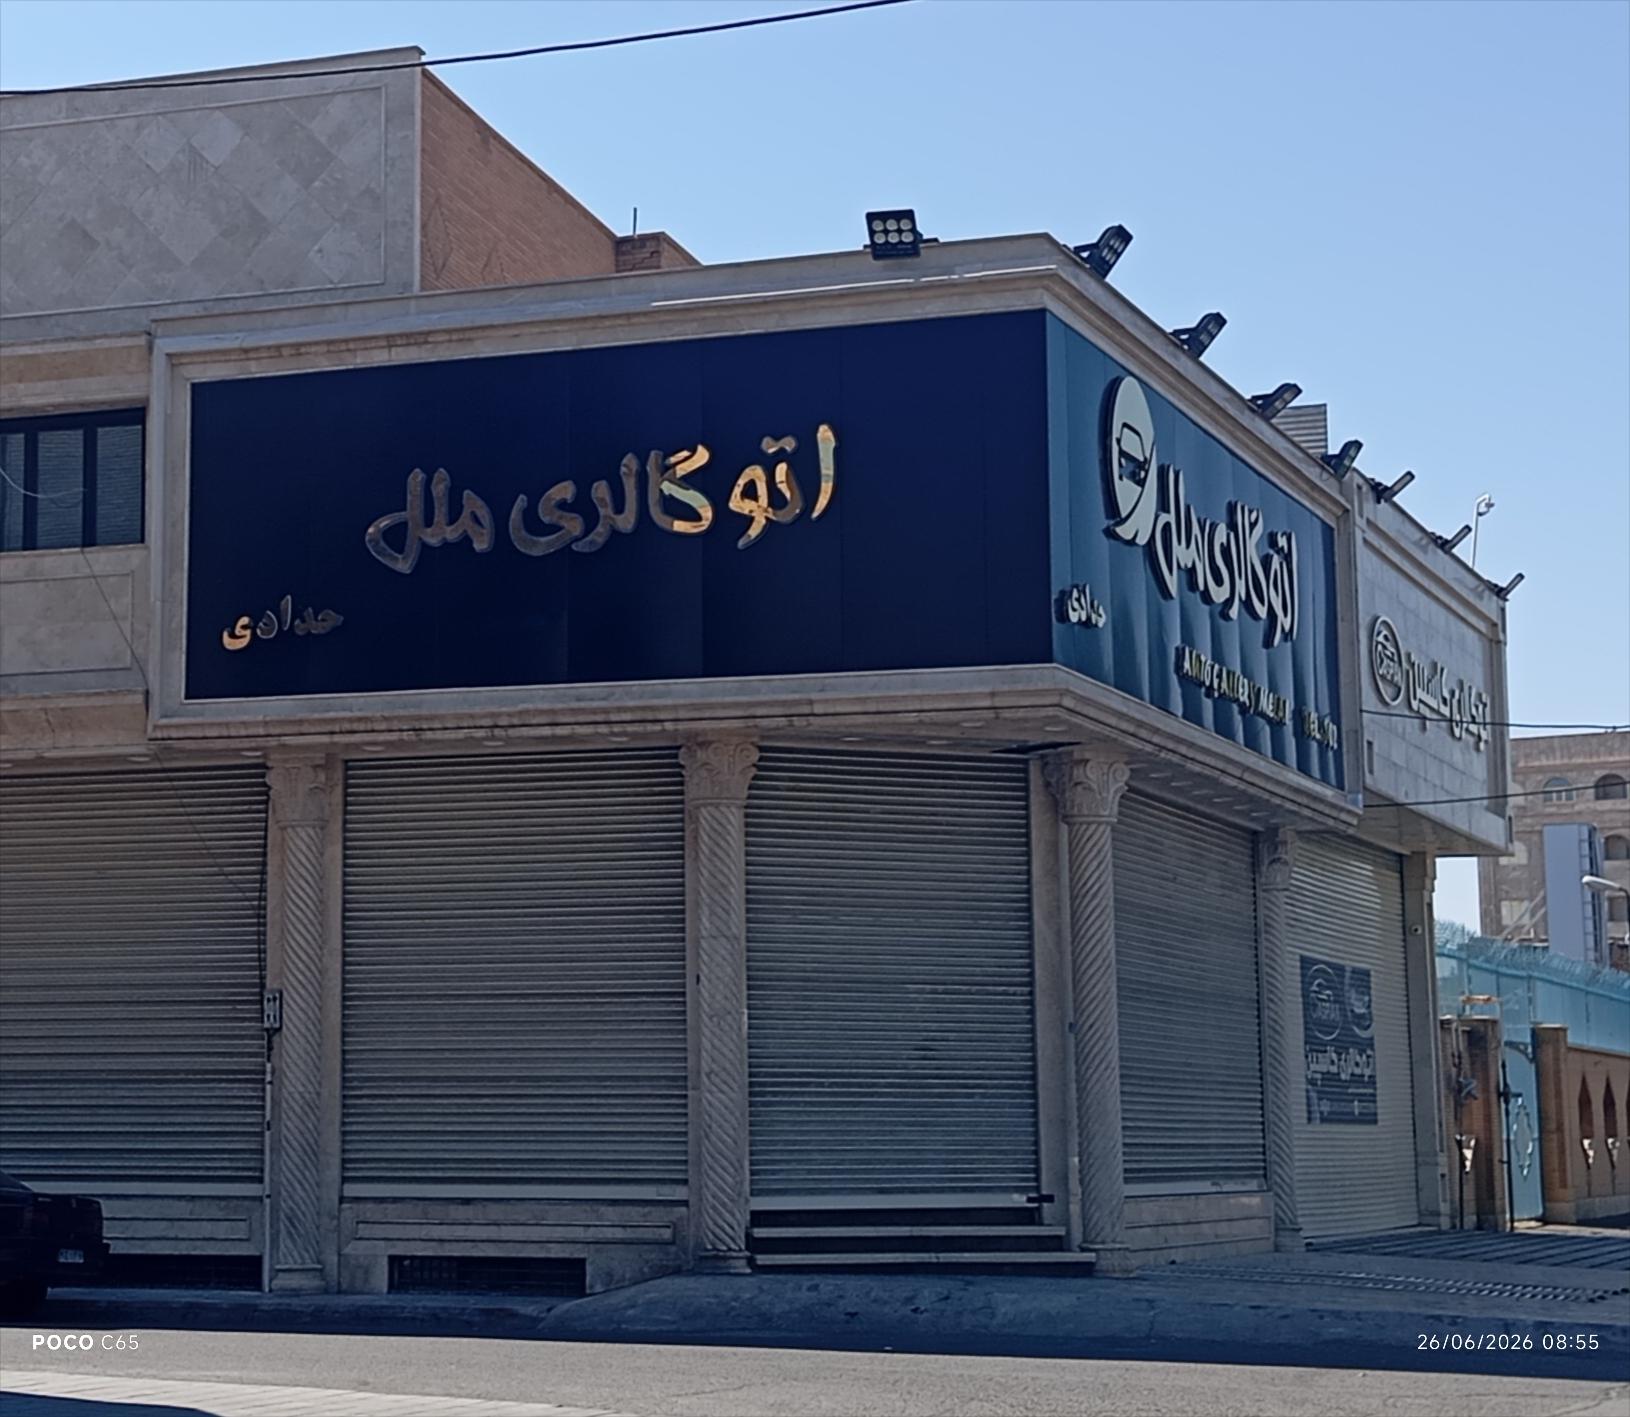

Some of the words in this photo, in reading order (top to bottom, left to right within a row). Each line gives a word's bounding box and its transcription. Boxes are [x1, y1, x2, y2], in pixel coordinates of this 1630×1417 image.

[364, 467, 495, 574] ملل
[509, 444, 714, 556] گالری
[728, 423, 839, 550] اتو
[1154, 463, 1205, 600] ملل
[221, 594, 344, 651] حدادی
